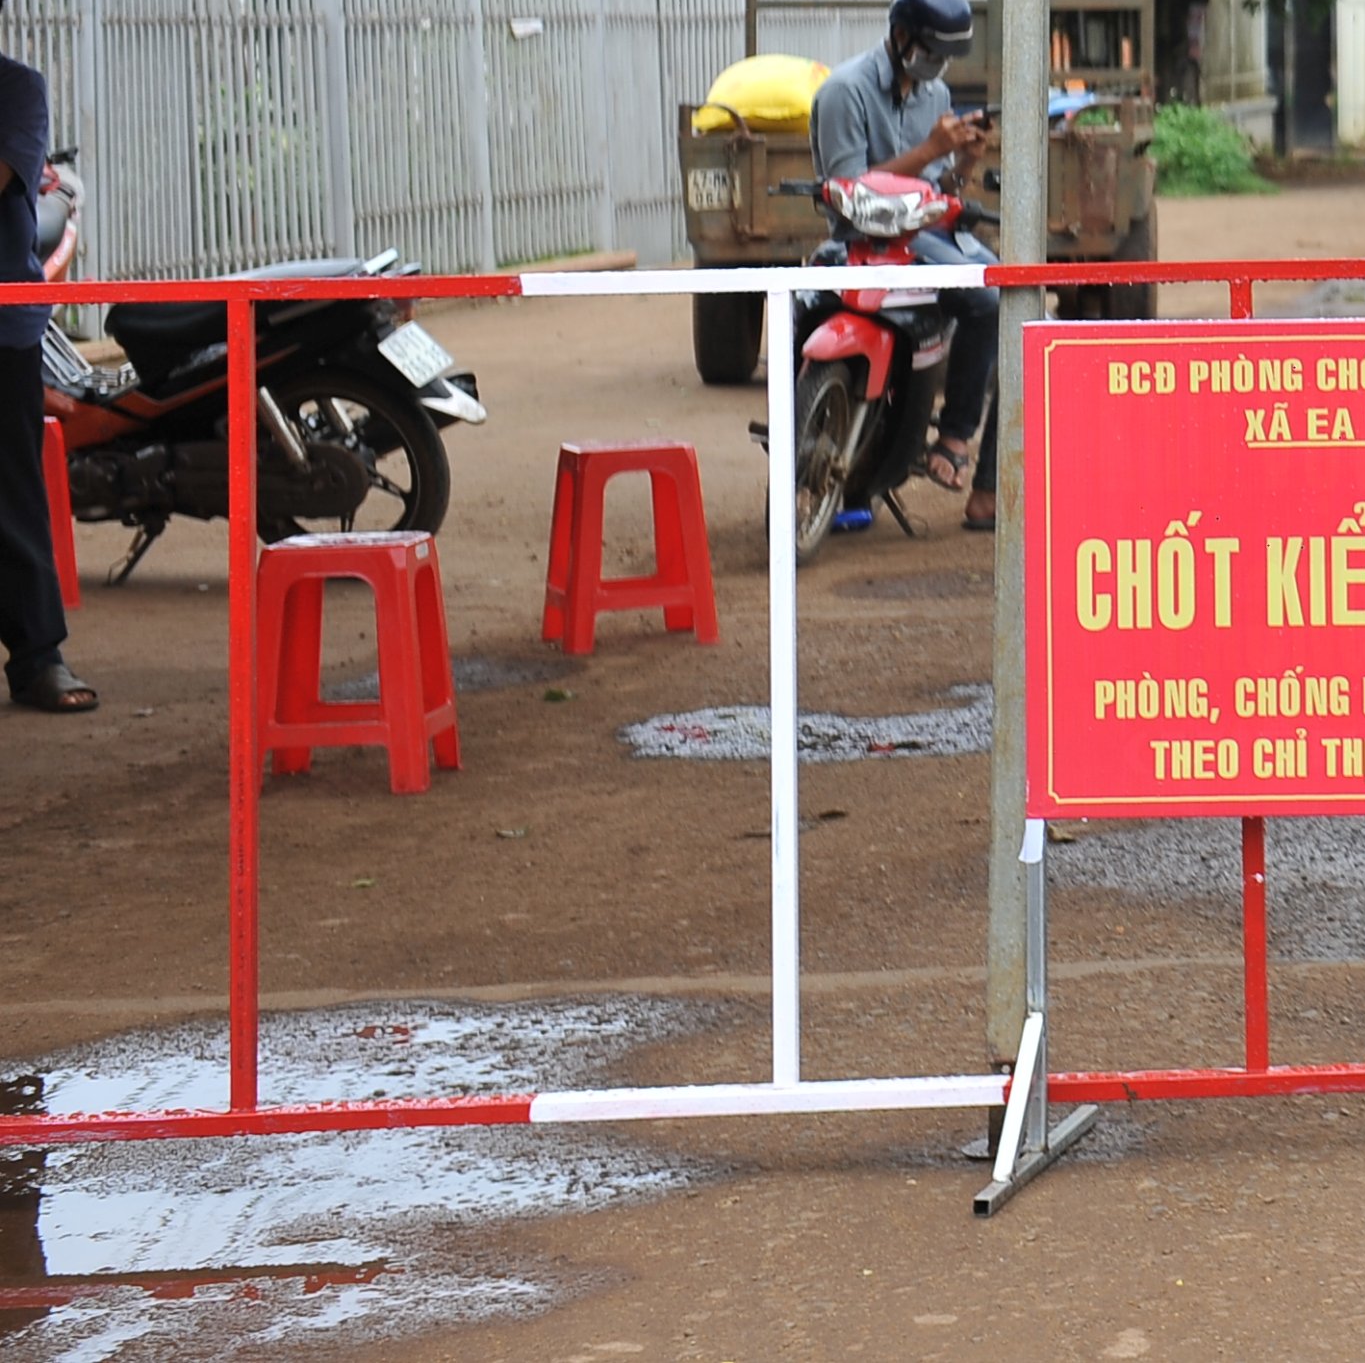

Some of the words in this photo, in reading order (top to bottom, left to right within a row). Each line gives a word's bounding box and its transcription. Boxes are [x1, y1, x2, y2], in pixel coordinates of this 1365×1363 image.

[1109, 362, 1175, 394] BCĐ
[1190, 358, 1302, 392] PHÒNG
[1245, 403, 1291, 439] XÃ
[1308, 408, 1354, 439] EA
[1077, 511, 1239, 630] CHỐT
[1095, 672, 1219, 723] PHÒNG,
[1236, 666, 1349, 717] CHỐNG
[1150, 739, 1238, 779] THEO
[1254, 728, 1307, 778] CHỈ
